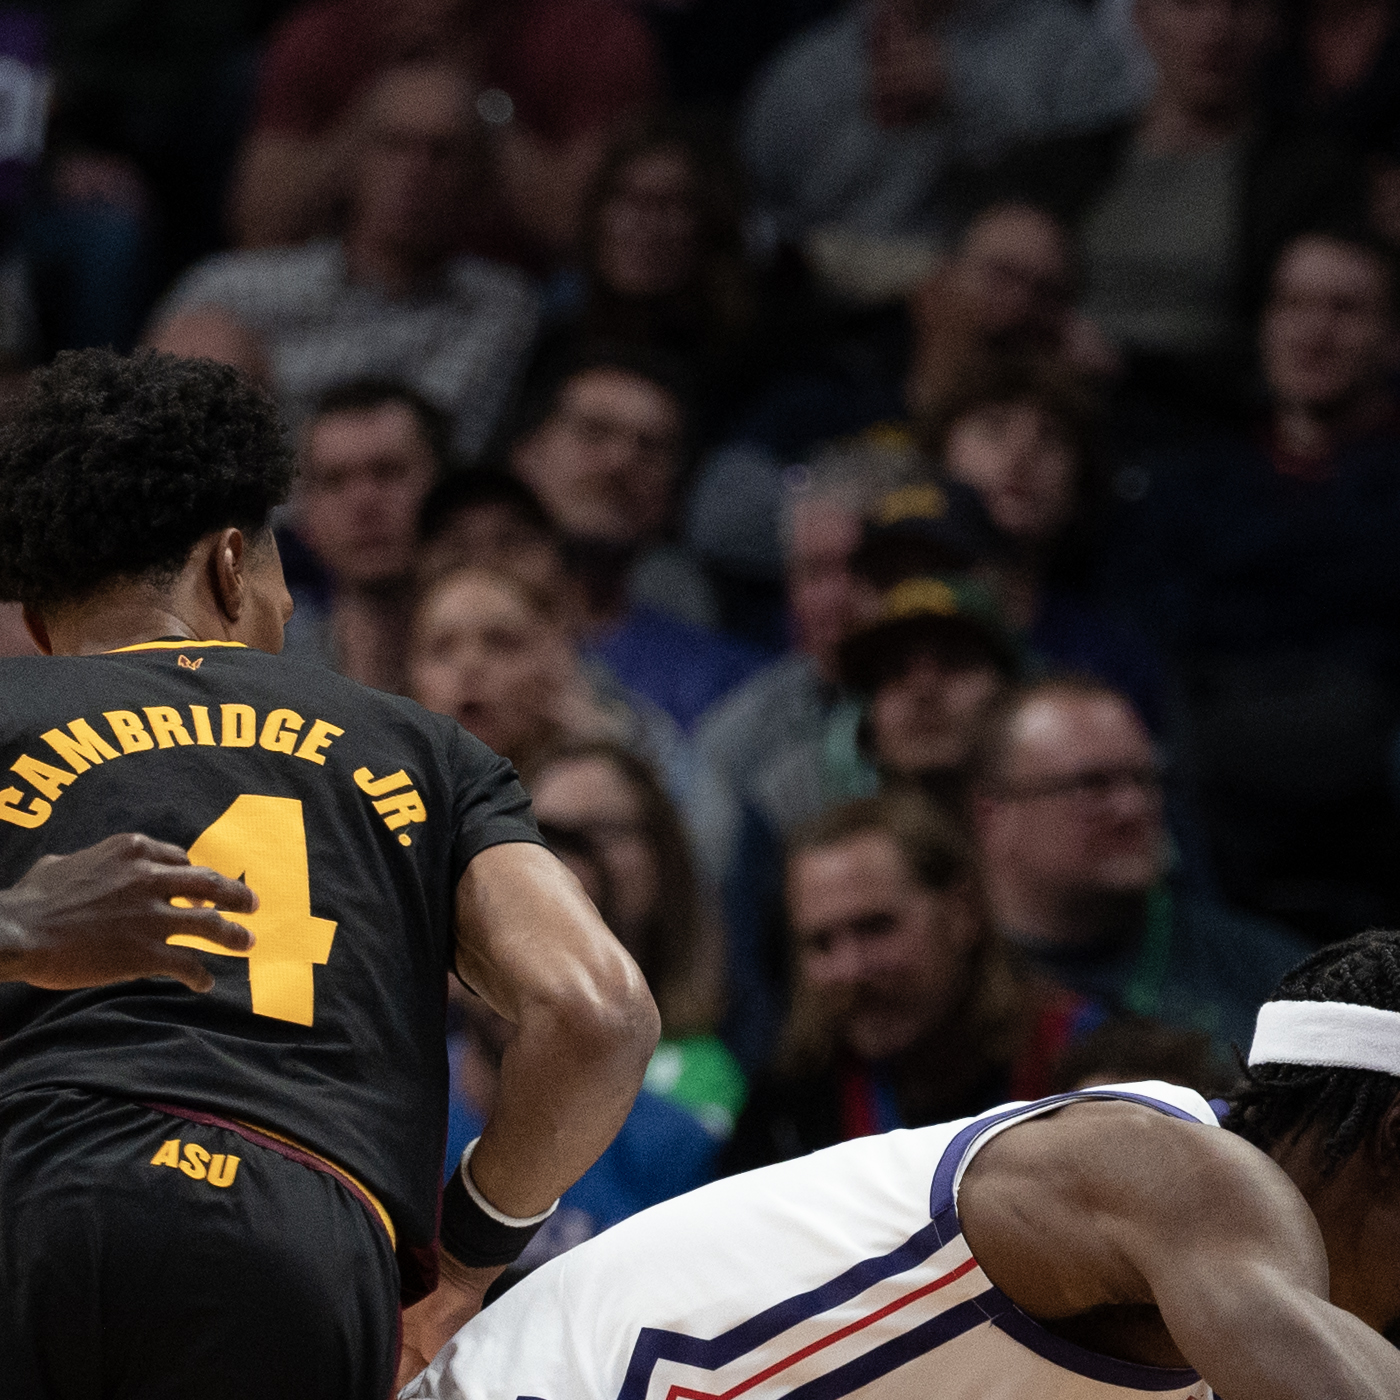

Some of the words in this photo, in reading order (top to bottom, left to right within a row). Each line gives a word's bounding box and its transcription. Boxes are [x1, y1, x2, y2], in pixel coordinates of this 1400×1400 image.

[353, 766, 428, 848] JR.
[166, 794, 338, 1027] 4
[150, 1138, 241, 1189] ASU
